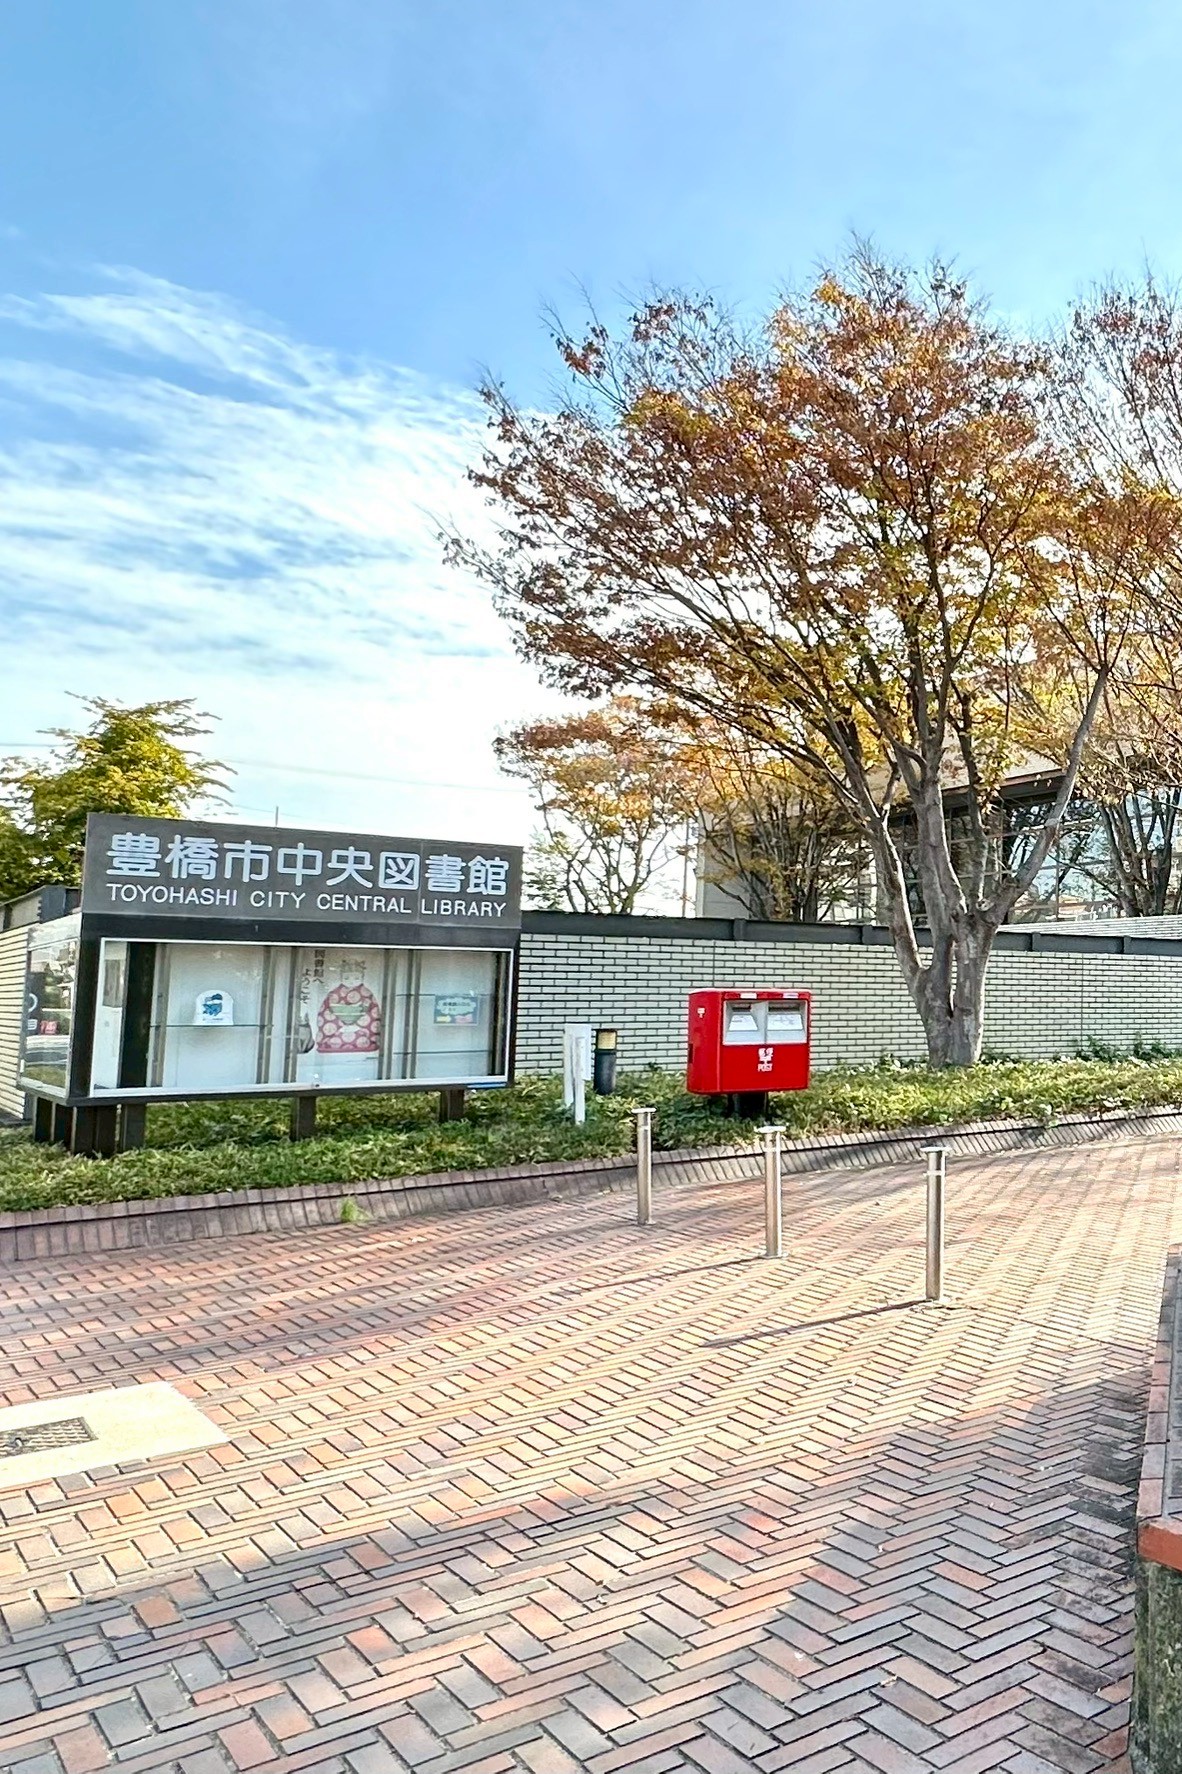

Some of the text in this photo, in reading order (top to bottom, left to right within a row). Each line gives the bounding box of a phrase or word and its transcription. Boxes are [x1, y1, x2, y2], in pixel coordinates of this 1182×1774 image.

[106, 832, 510, 896] 豊橋市中央図書館
[105, 883, 507, 917] TOYOHASHI CITY CENTRAL LIBRARY
